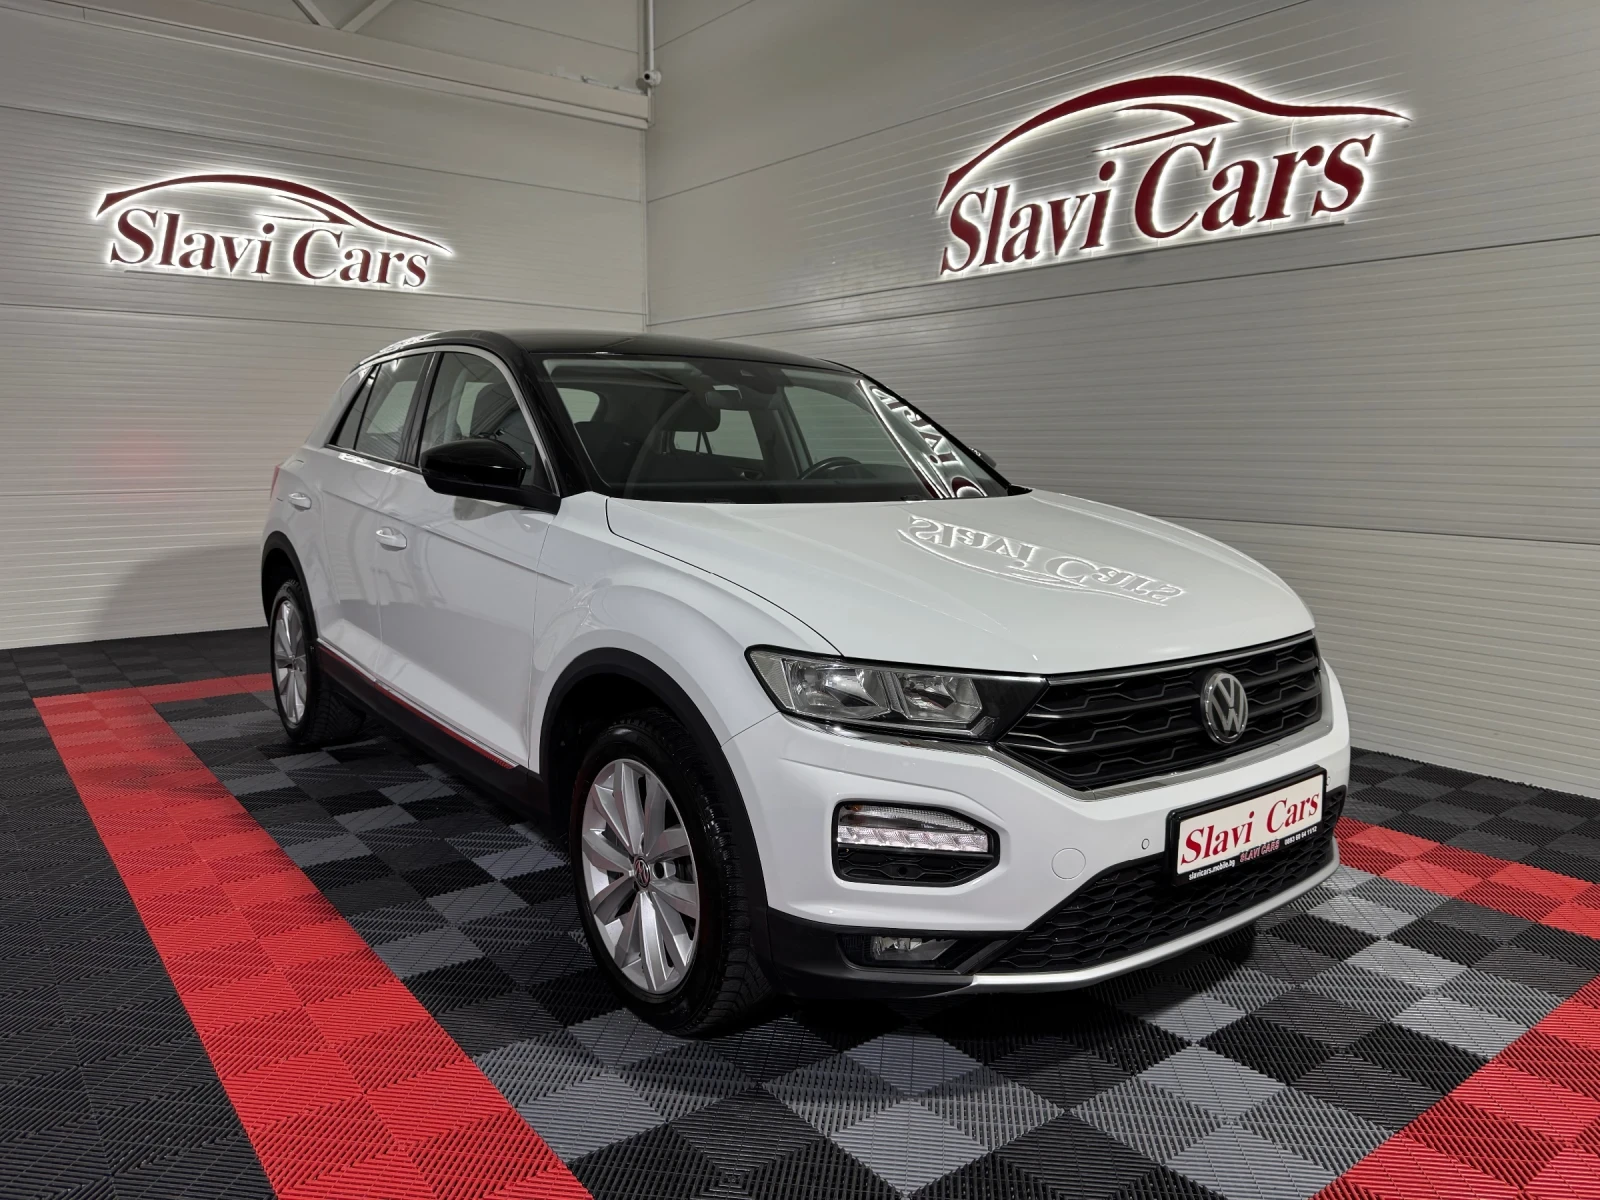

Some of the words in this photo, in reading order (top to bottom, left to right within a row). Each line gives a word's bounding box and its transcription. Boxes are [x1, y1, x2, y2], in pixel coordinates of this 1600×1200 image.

[939, 160, 1117, 276] Slavi
[1134, 134, 1375, 240] Cars
[109, 208, 274, 275] Slavi
[292, 229, 429, 288] Cars
[1180, 811, 1255, 866] Slavi
[1266, 793, 1320, 834] Cars
[1188, 859, 1236, 881] slavicars.mobile.bg
[1240, 847, 1260, 862] SLAVI
[1261, 840, 1280, 854] CARS
